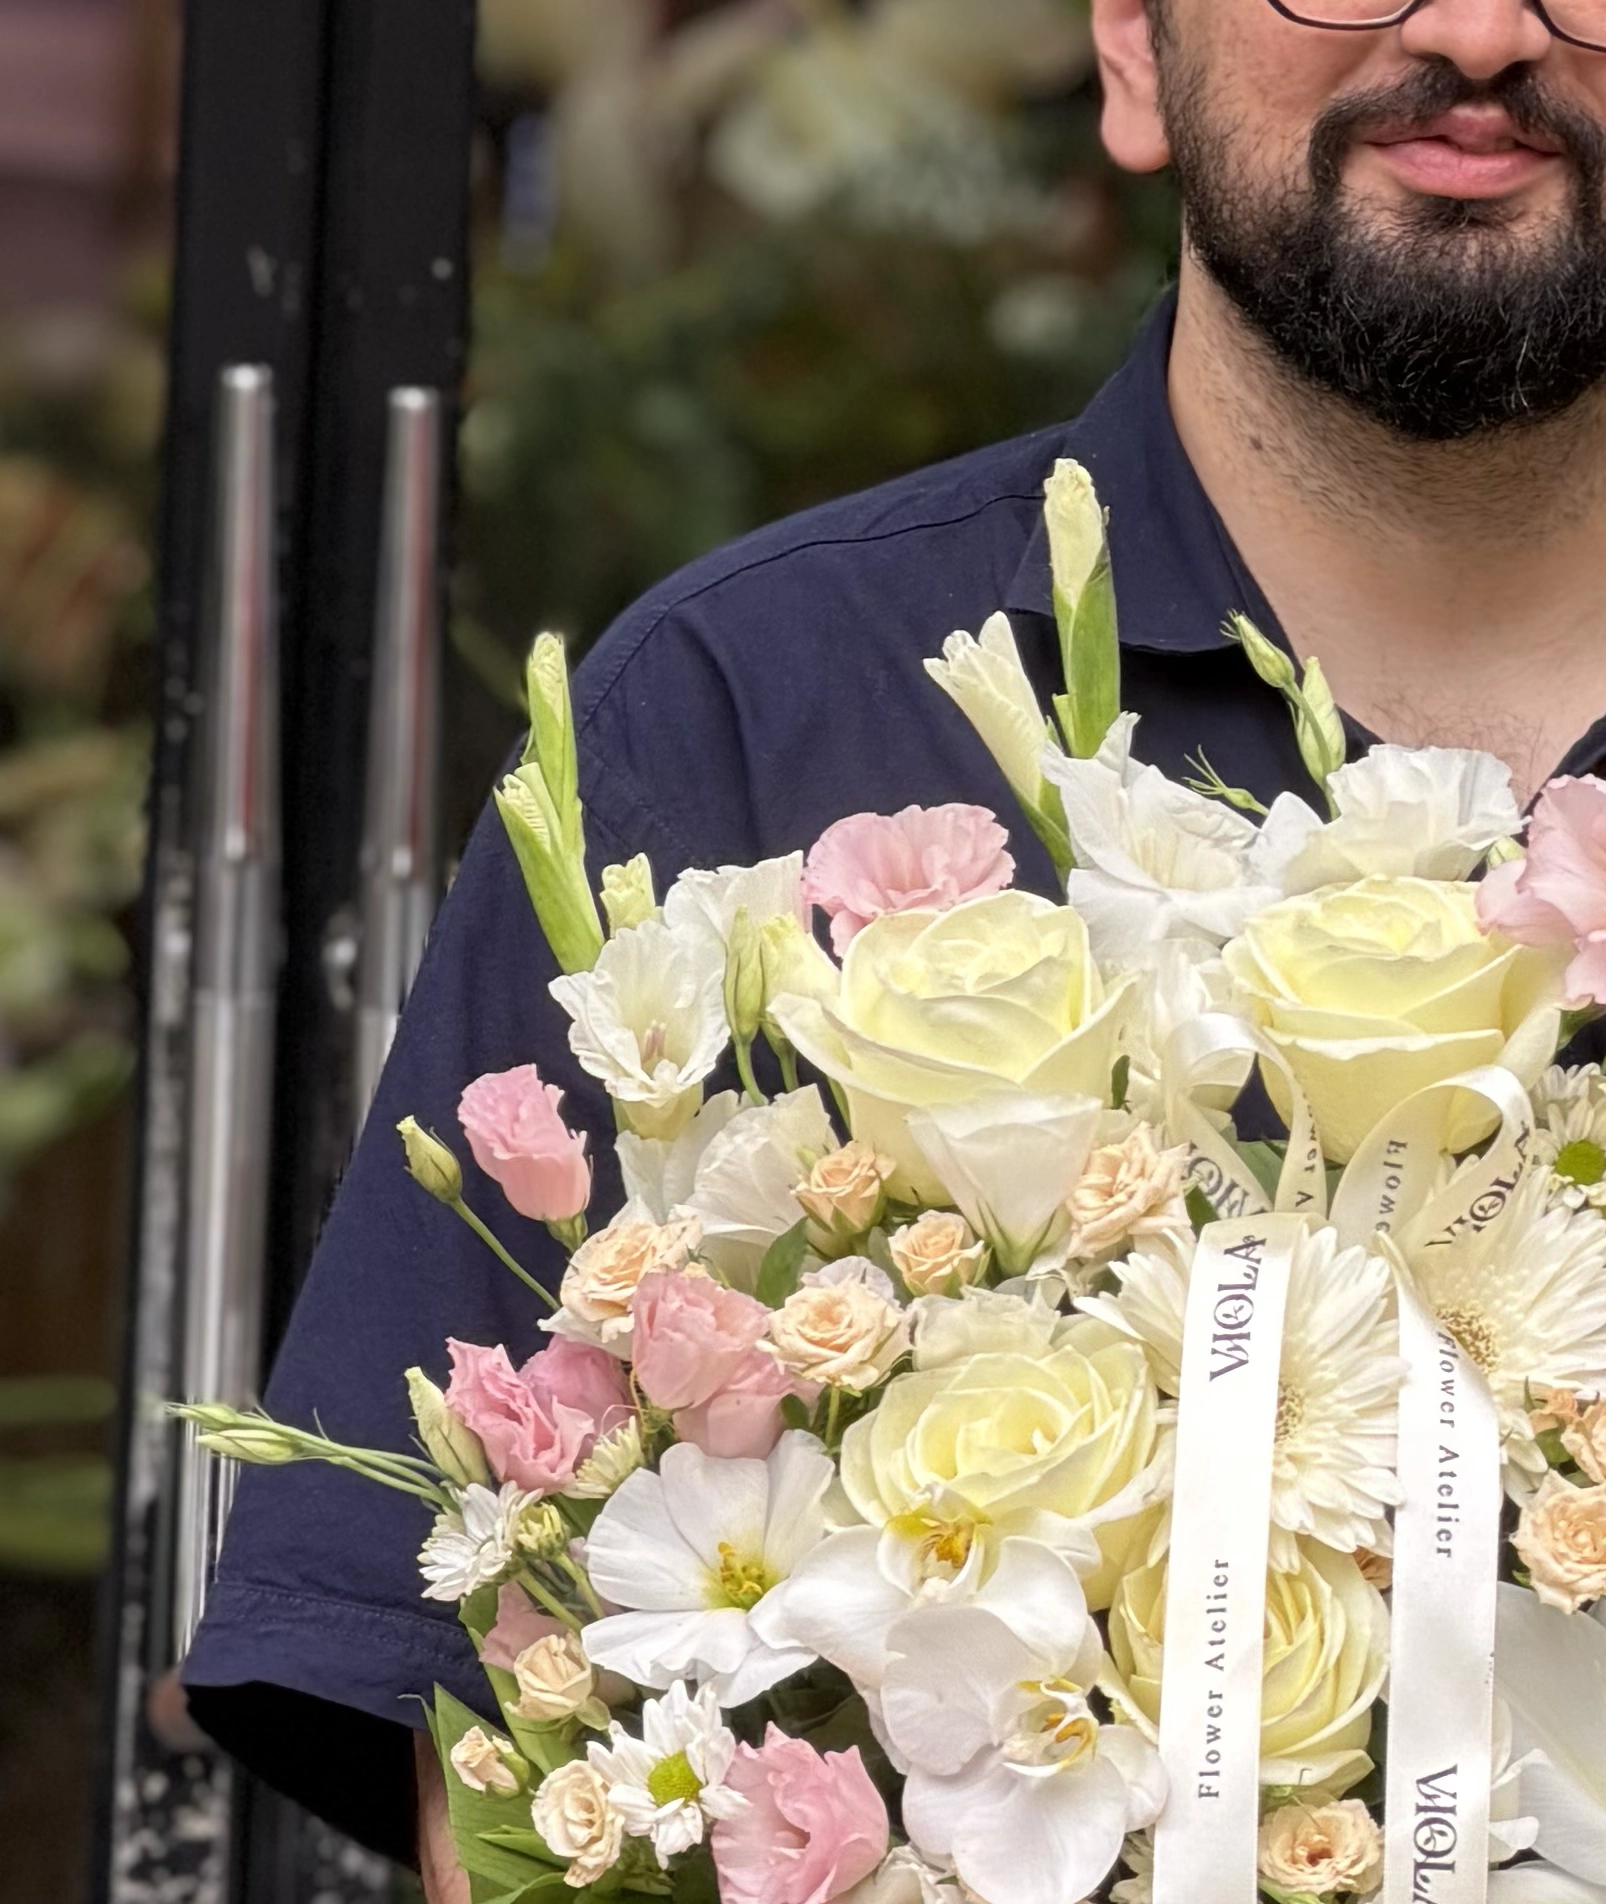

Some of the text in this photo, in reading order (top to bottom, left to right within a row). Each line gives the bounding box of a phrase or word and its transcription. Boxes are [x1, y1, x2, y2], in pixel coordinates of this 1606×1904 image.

[1208, 1234, 1267, 1383] VIOLA
[1435, 1330, 1460, 1558] Flower Atelier
[1198, 1559, 1229, 1799] Flower Atelier
